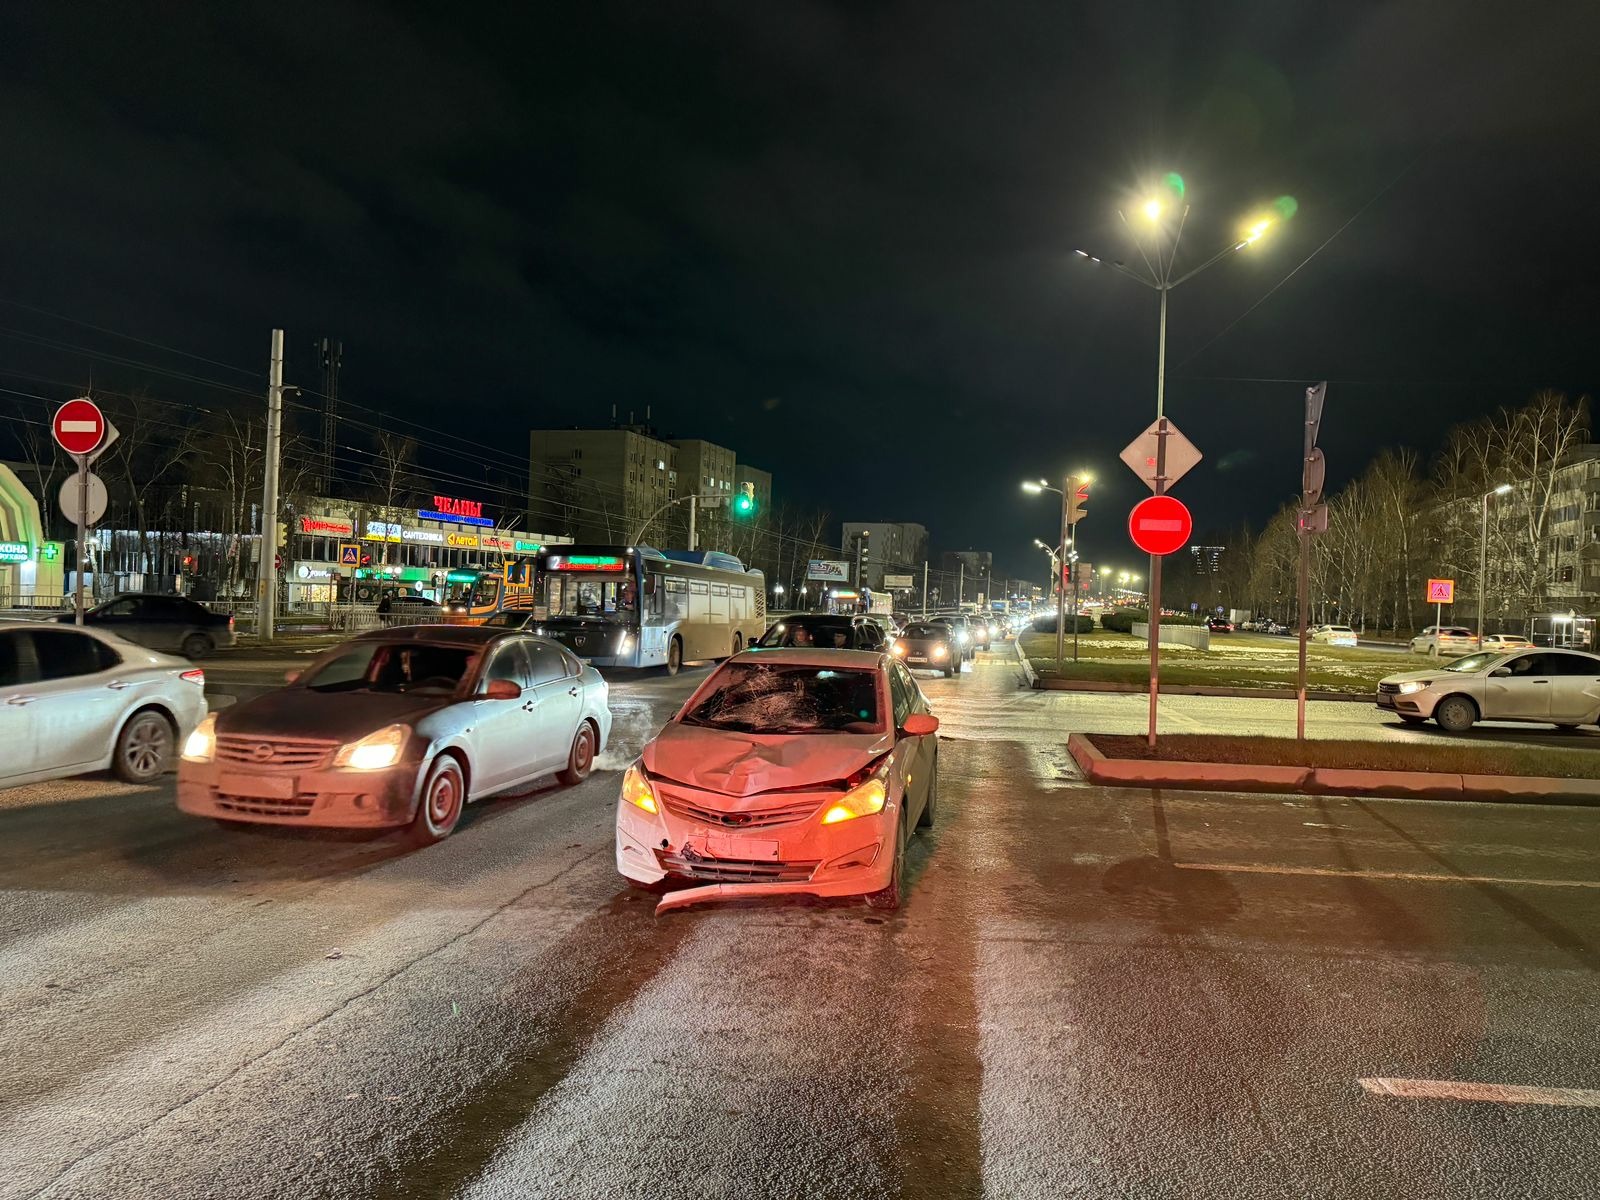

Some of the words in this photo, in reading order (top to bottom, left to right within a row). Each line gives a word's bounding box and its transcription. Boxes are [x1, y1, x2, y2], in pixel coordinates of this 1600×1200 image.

[433, 496, 482, 517] ЧЕЛНЫ
[402, 530, 444, 542] САНТЕХНИКА
[553, 556, 560, 569] 2
